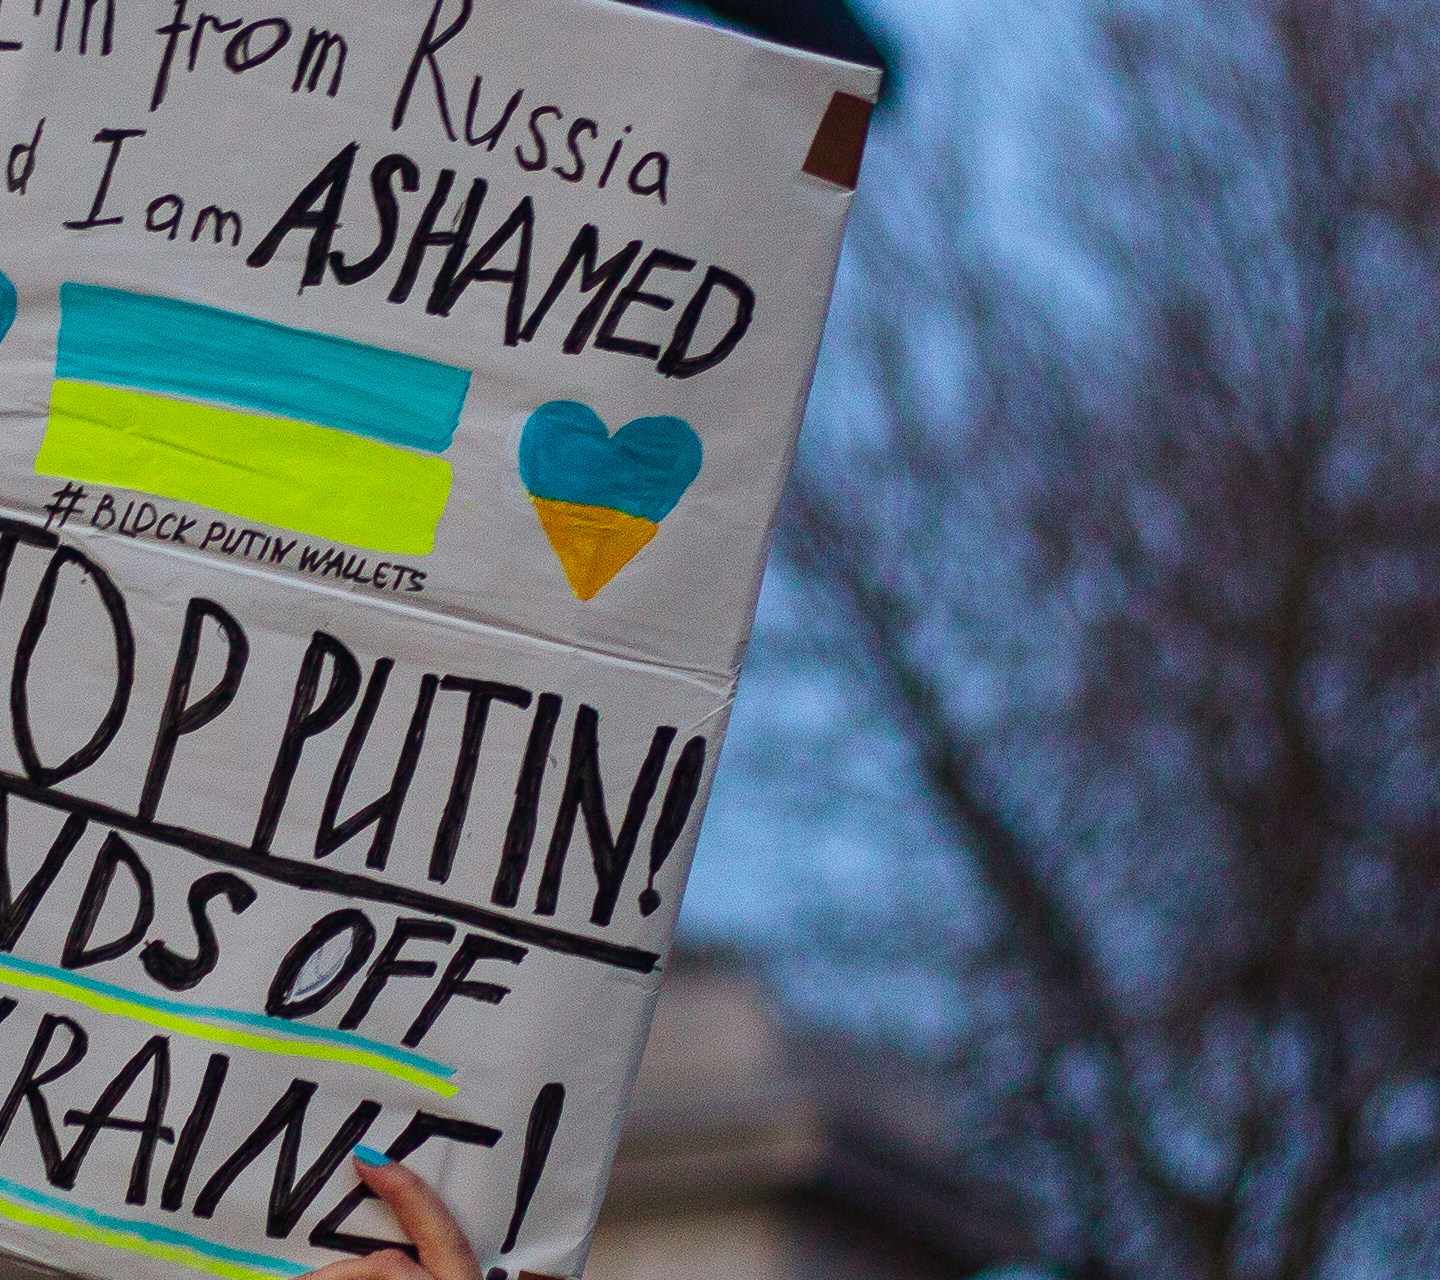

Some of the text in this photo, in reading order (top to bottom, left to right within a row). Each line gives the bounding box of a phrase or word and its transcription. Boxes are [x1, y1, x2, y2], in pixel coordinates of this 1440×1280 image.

[63, 128, 146, 232] I
[146, 194, 243, 247] am
[245, 141, 756, 378] ASHAMED
[199, 521, 297, 565] PUTIN
[299, 545, 427, 593] WALLETS
[257, 629, 706, 926] PUTIN!
[265, 909, 528, 1047] OFF
